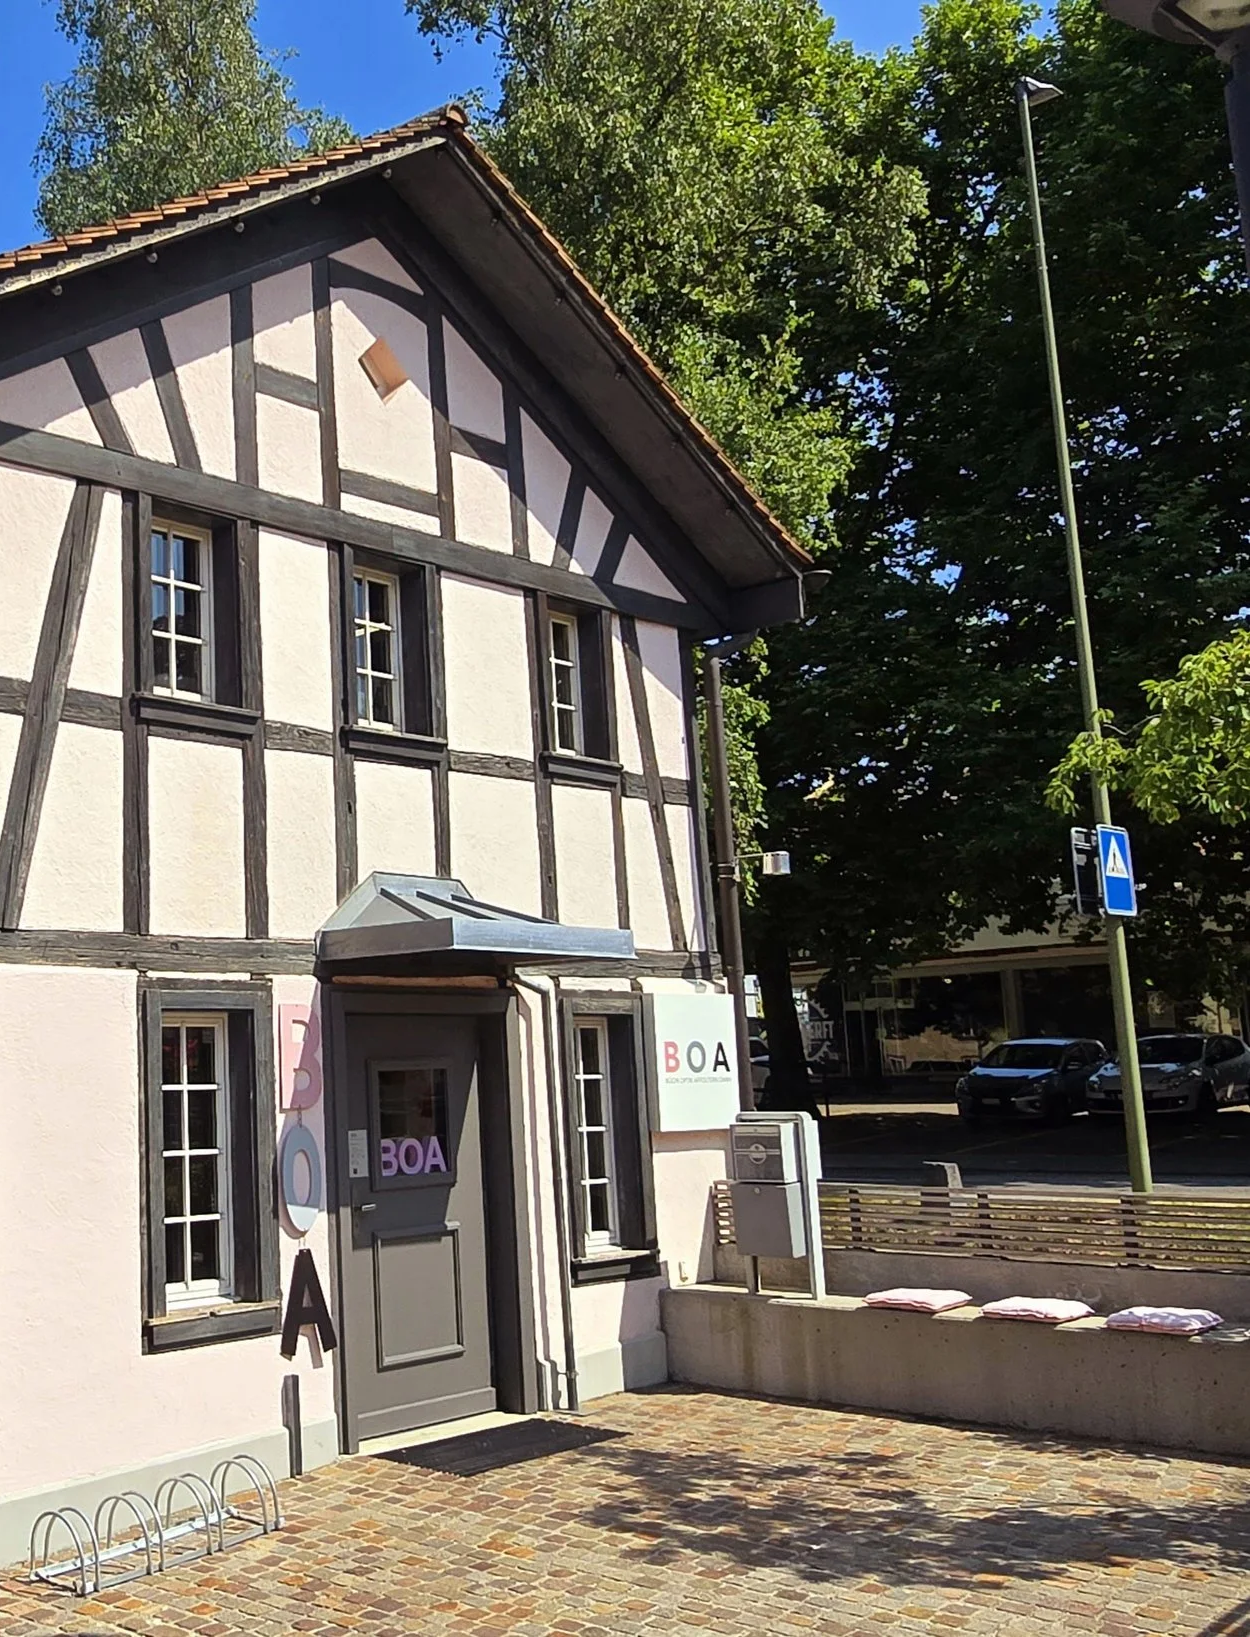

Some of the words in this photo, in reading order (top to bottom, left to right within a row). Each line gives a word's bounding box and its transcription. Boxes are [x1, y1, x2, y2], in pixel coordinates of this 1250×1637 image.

[664, 1041, 731, 1073] BOA
[380, 1135, 447, 1177] BOA
[279, 1003, 337, 1361] BOA
